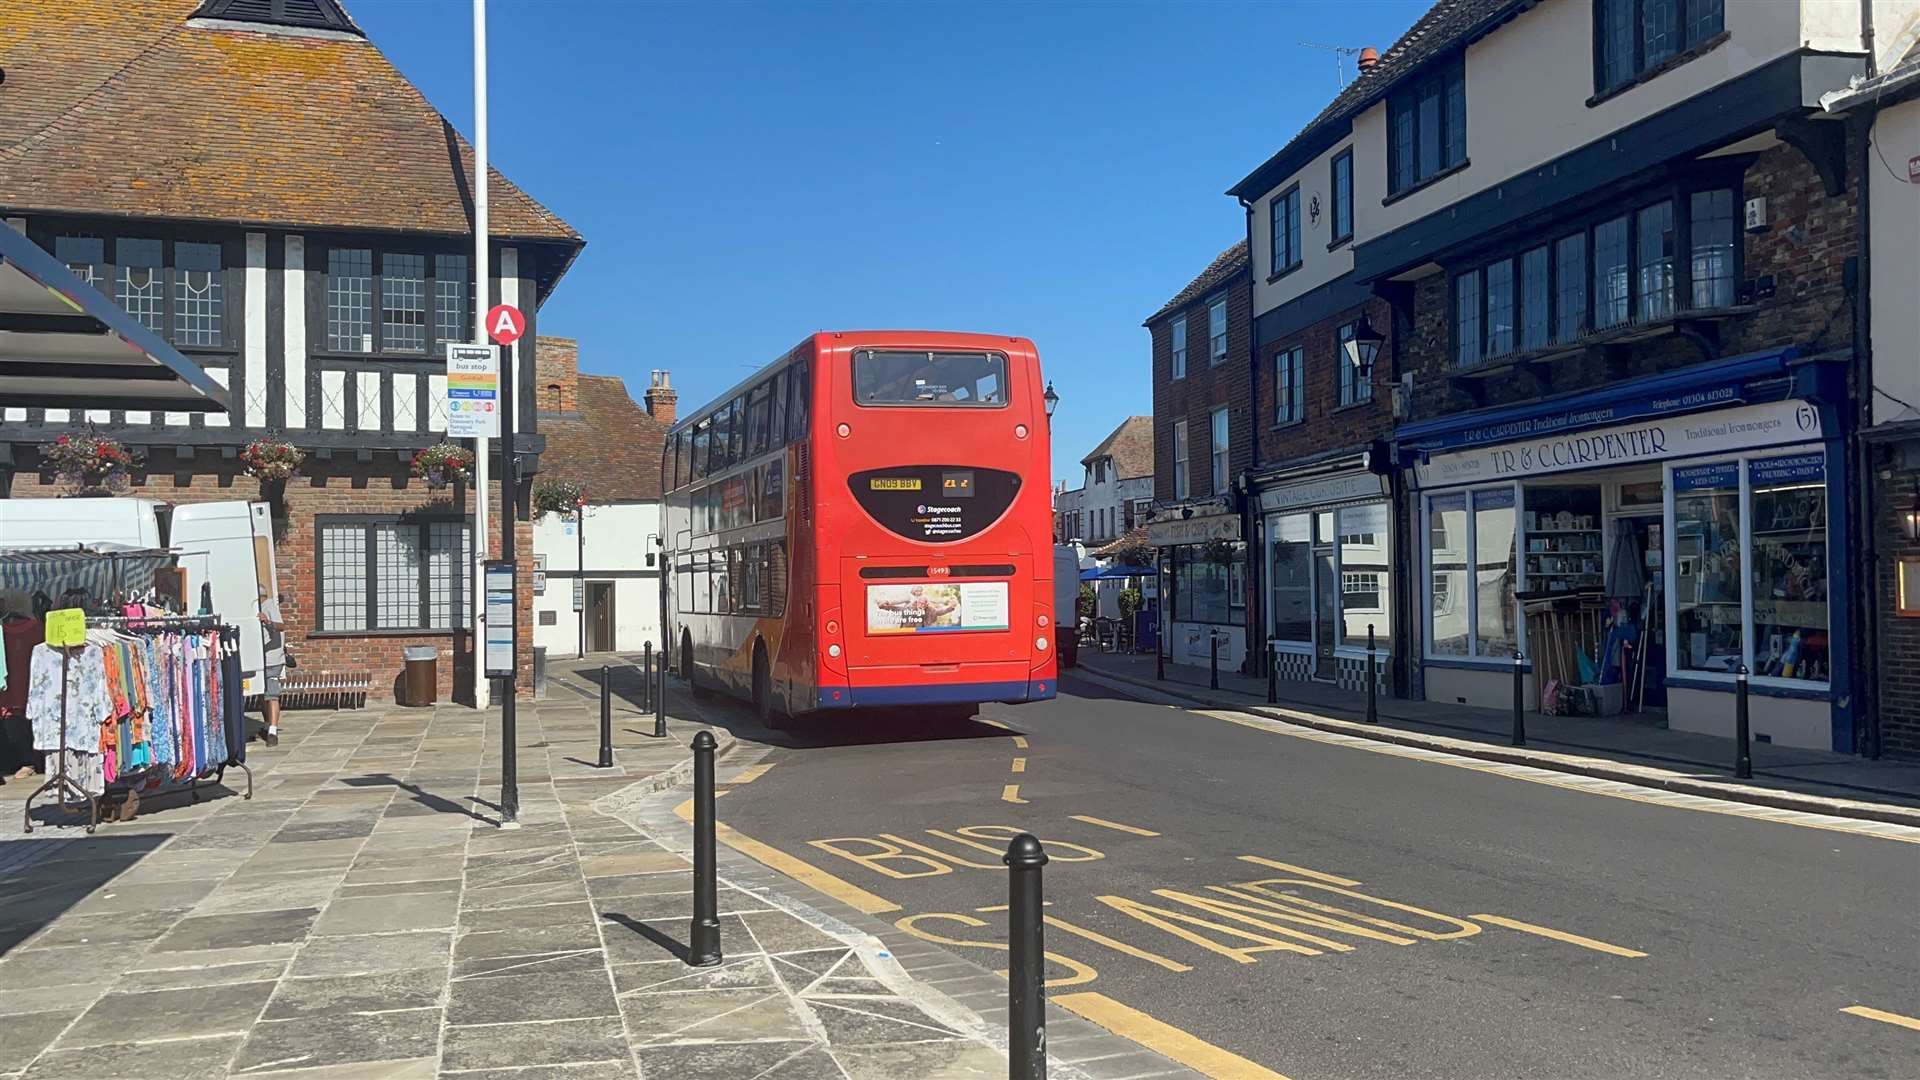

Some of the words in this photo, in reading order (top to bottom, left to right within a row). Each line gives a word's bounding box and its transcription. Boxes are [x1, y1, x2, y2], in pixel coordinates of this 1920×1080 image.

[494, 310, 517, 334] A
[1684, 421, 1727, 440] Traditional
[1728, 418, 1781, 435] Ironmongers
[1796, 404, 1818, 432] (5)
[1520, 447, 1533, 471] &
[927, 506, 961, 514] Stagecoach
[903, 607, 925, 618] things
[807, 825, 1106, 879] BUS
[895, 878, 1482, 988] STAND
